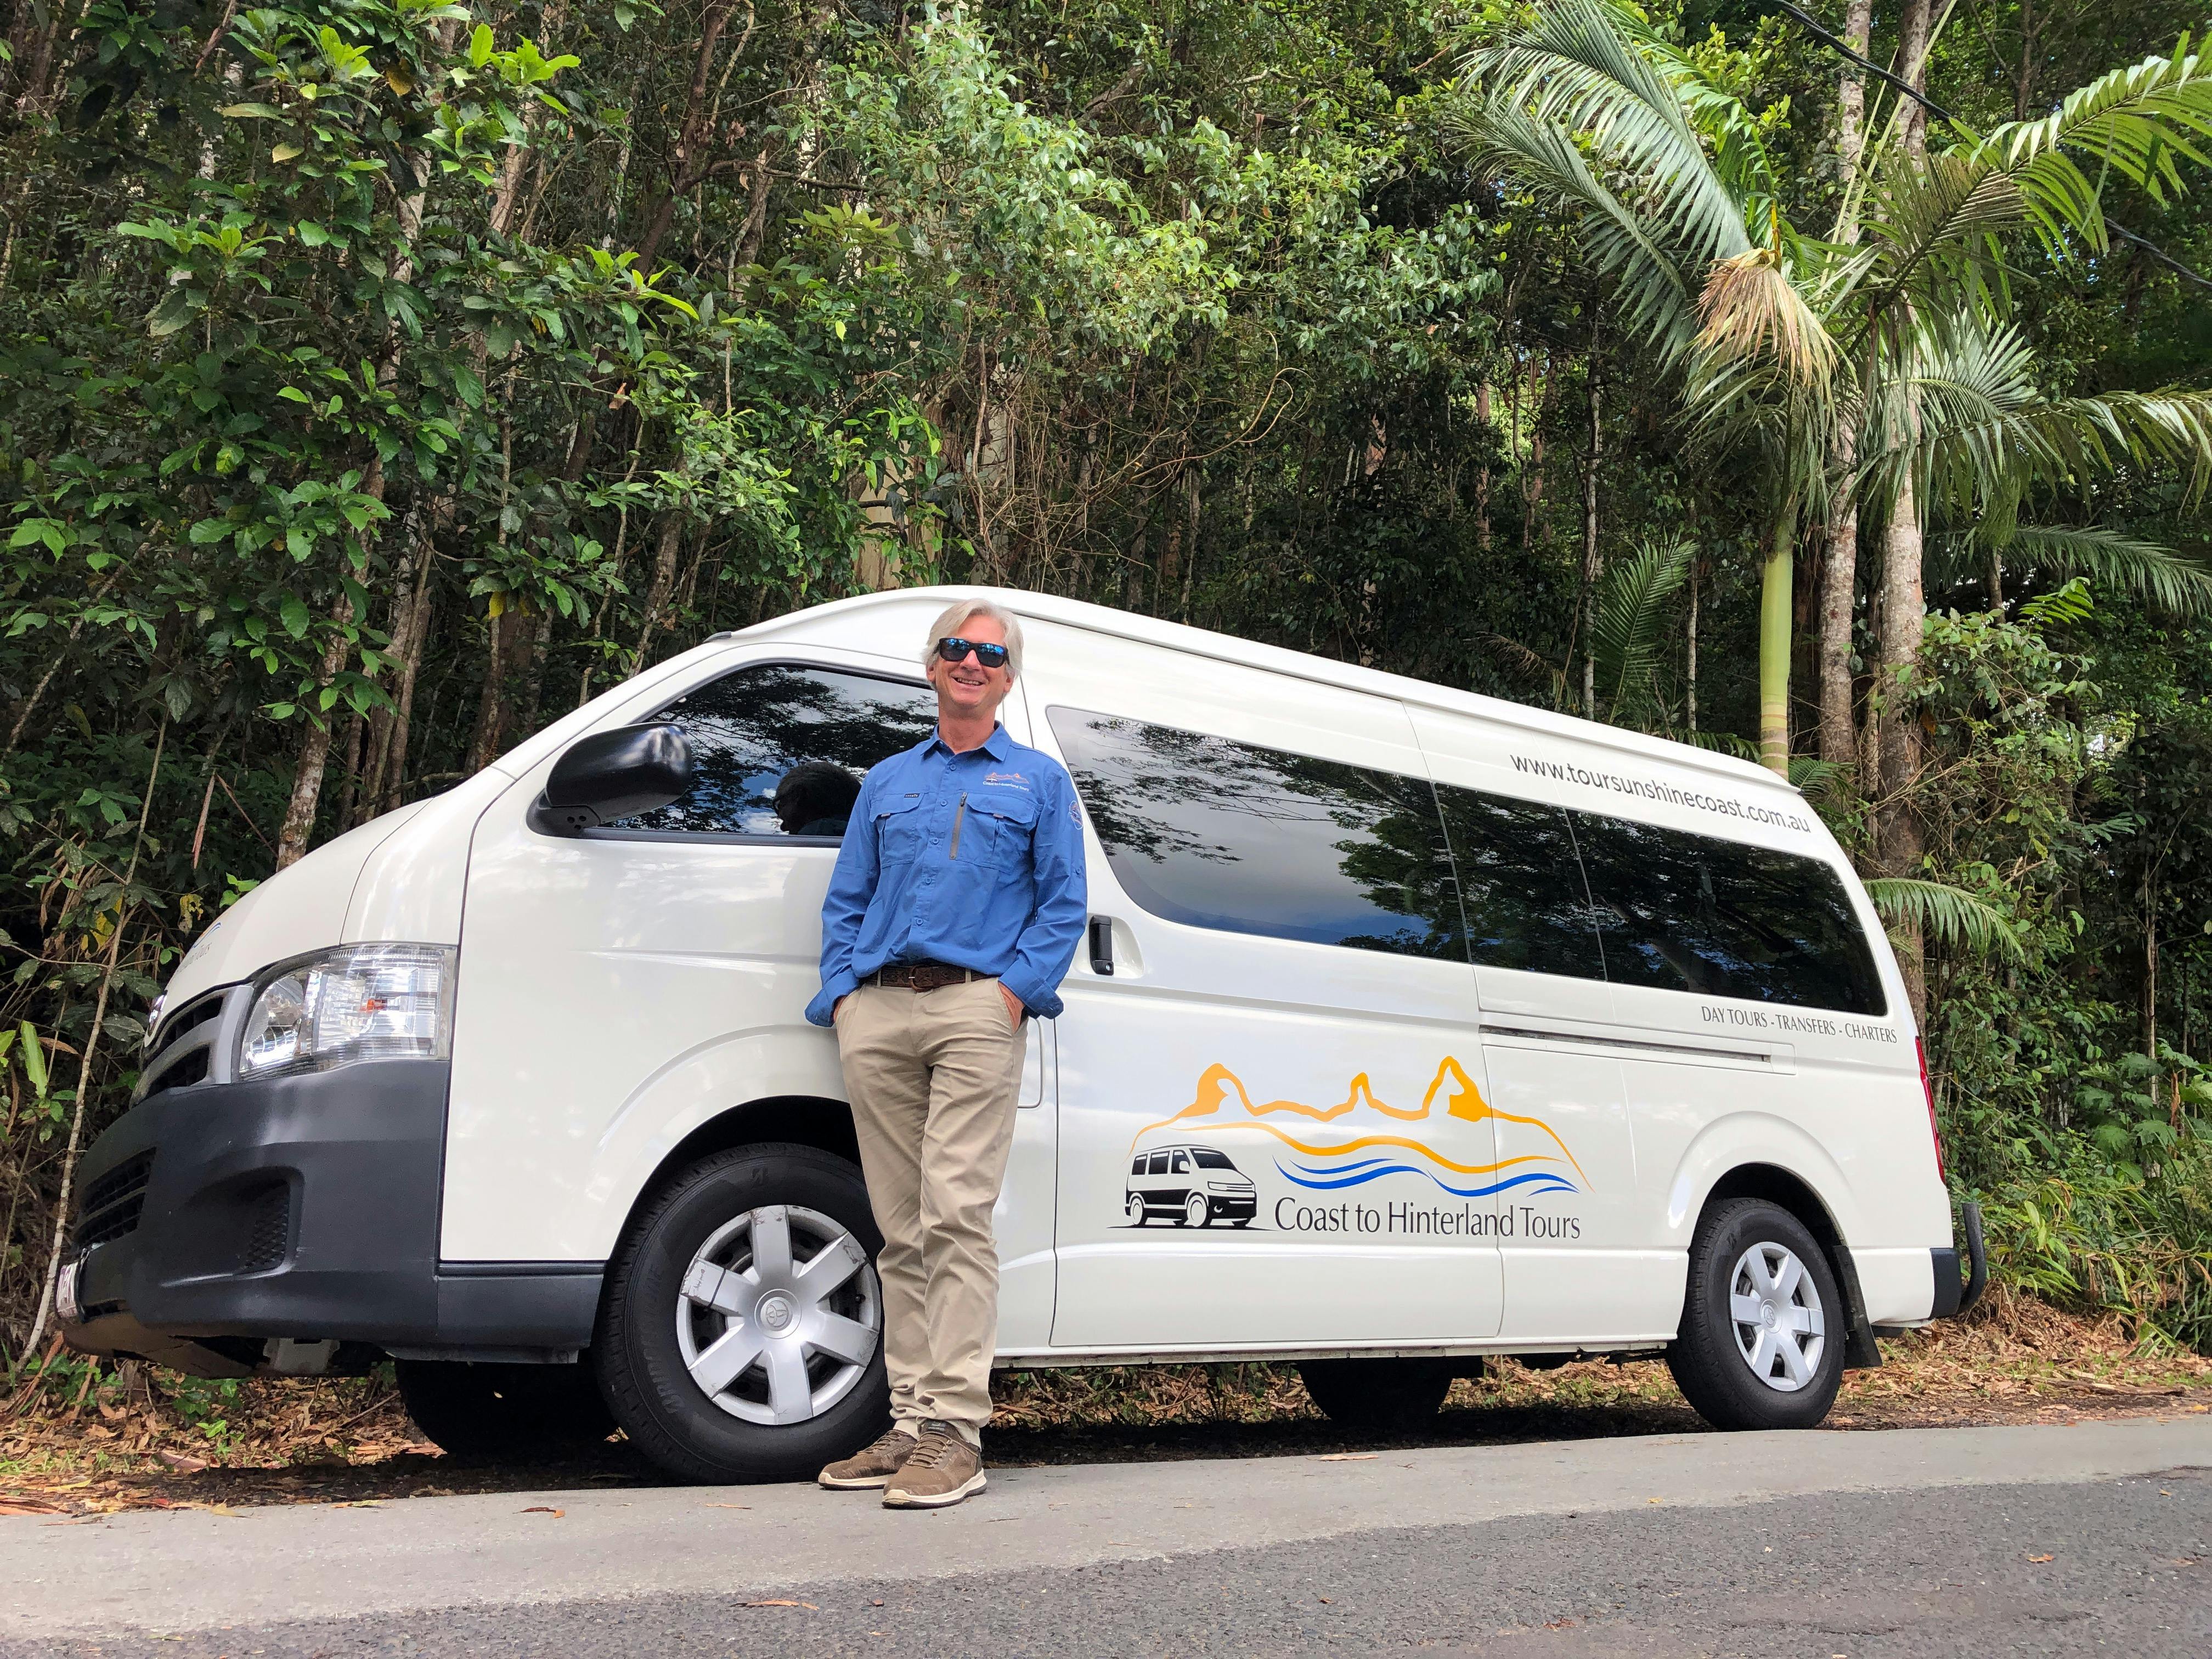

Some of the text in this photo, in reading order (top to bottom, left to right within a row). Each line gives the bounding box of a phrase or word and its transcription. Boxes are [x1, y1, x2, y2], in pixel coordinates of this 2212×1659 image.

[1510, 754, 1812, 833] www.toursunshinecoast.com.au
[1701, 1006, 1725, 1023] DAY
[1726, 1008, 1768, 1028] TOURS
[1775, 1014, 1836, 1036] TRANSFERS
[1845, 1023, 1897, 1043] CHARTERS
[1275, 1197, 1581, 1239] Coast to Hinterland Tours
